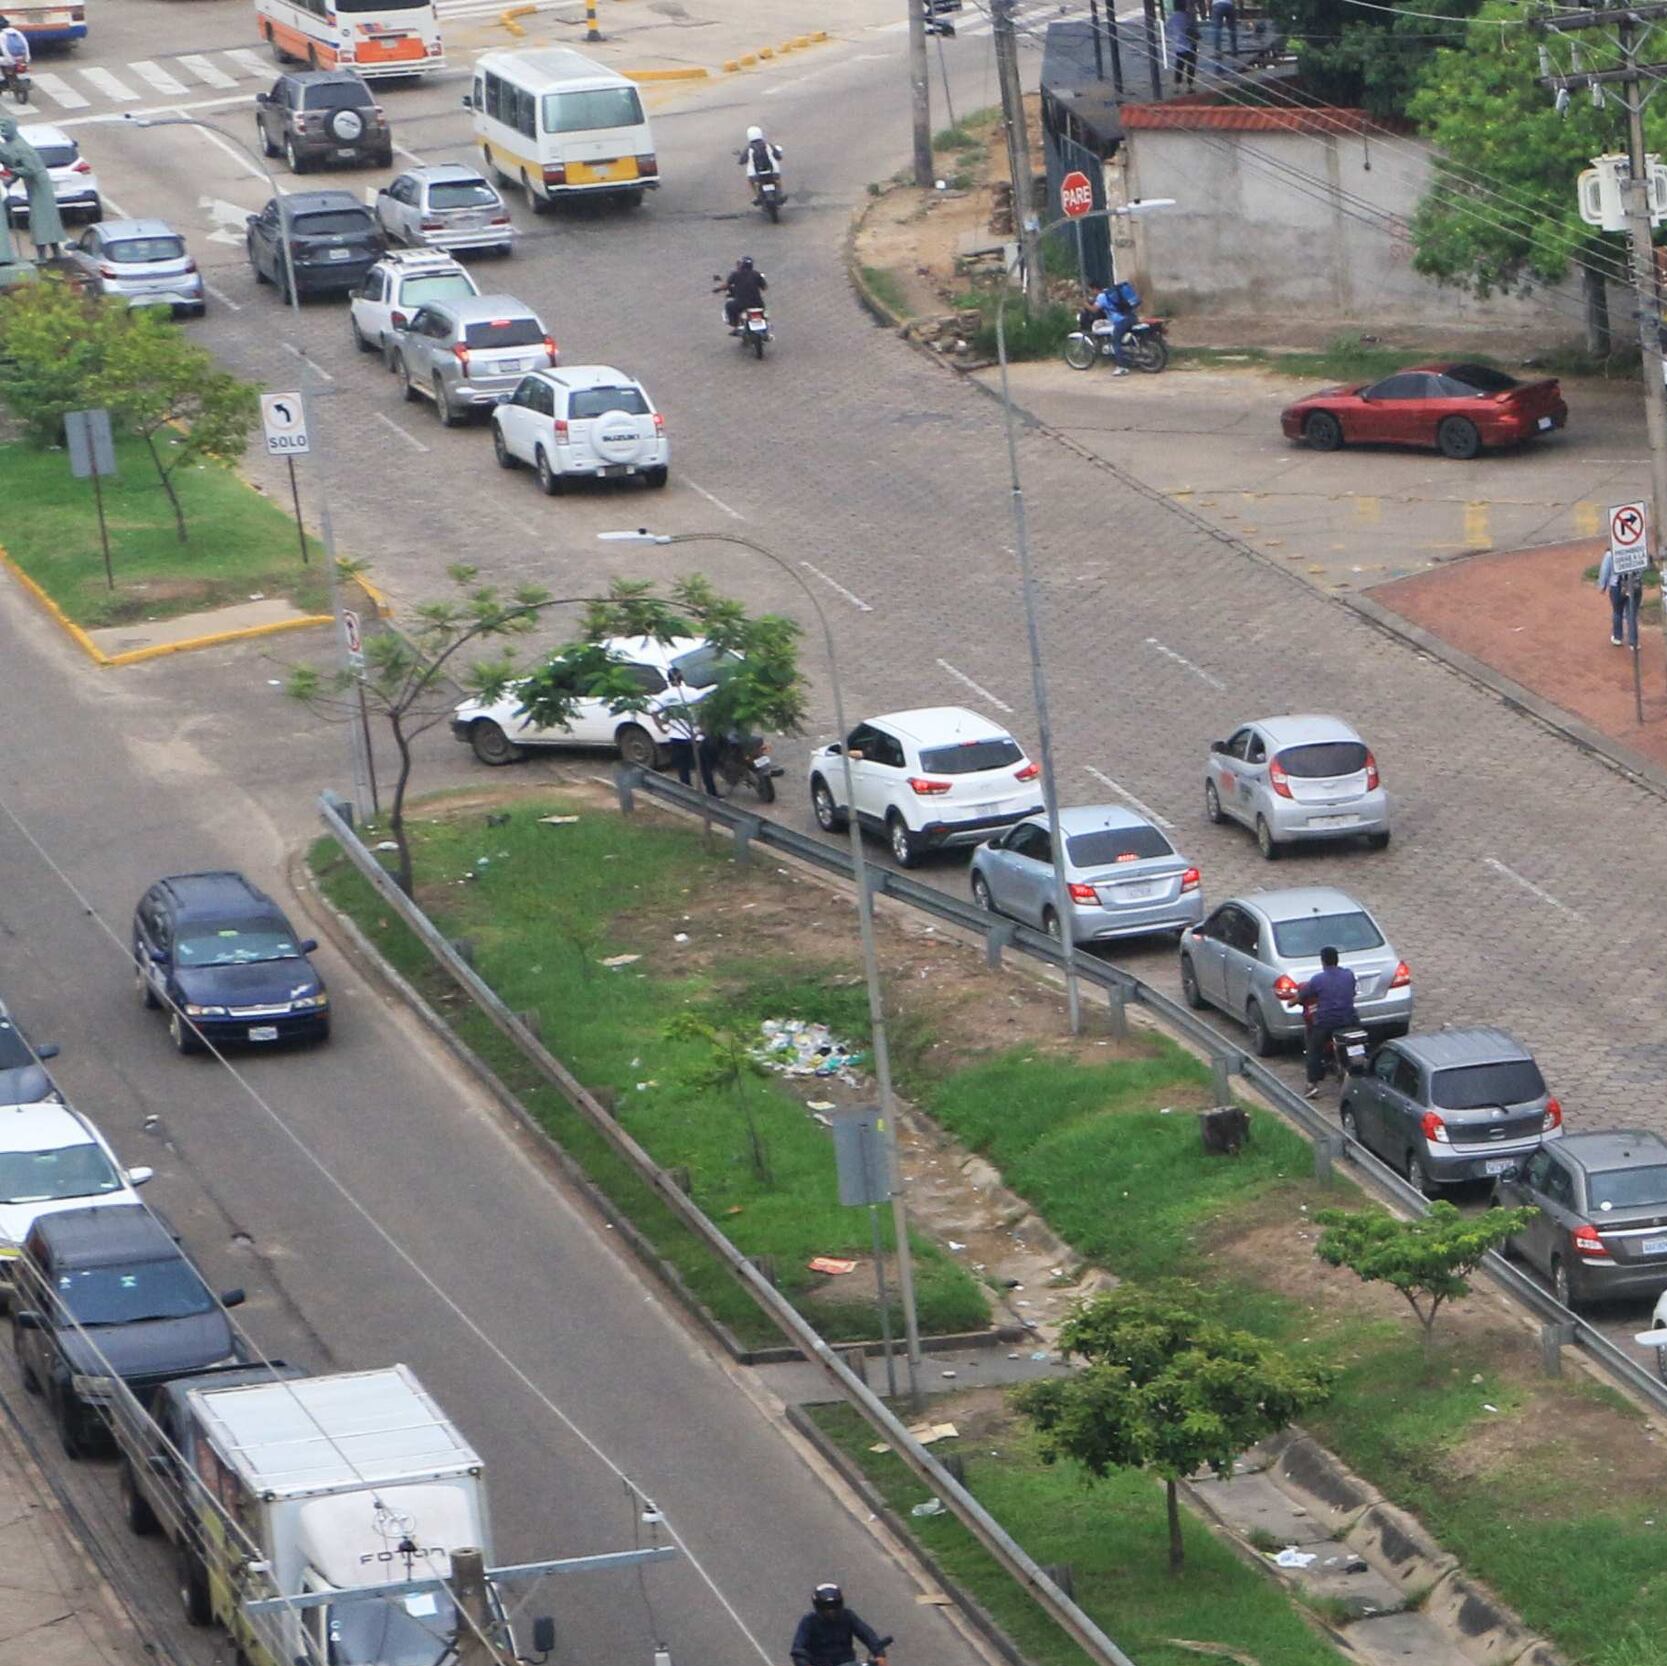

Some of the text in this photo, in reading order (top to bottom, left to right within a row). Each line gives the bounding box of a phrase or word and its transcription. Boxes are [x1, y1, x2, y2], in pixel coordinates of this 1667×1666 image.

[1063, 185, 1091, 206] PARE
[269, 435, 306, 448] SOLO
[602, 434, 639, 442] SUZUKI
